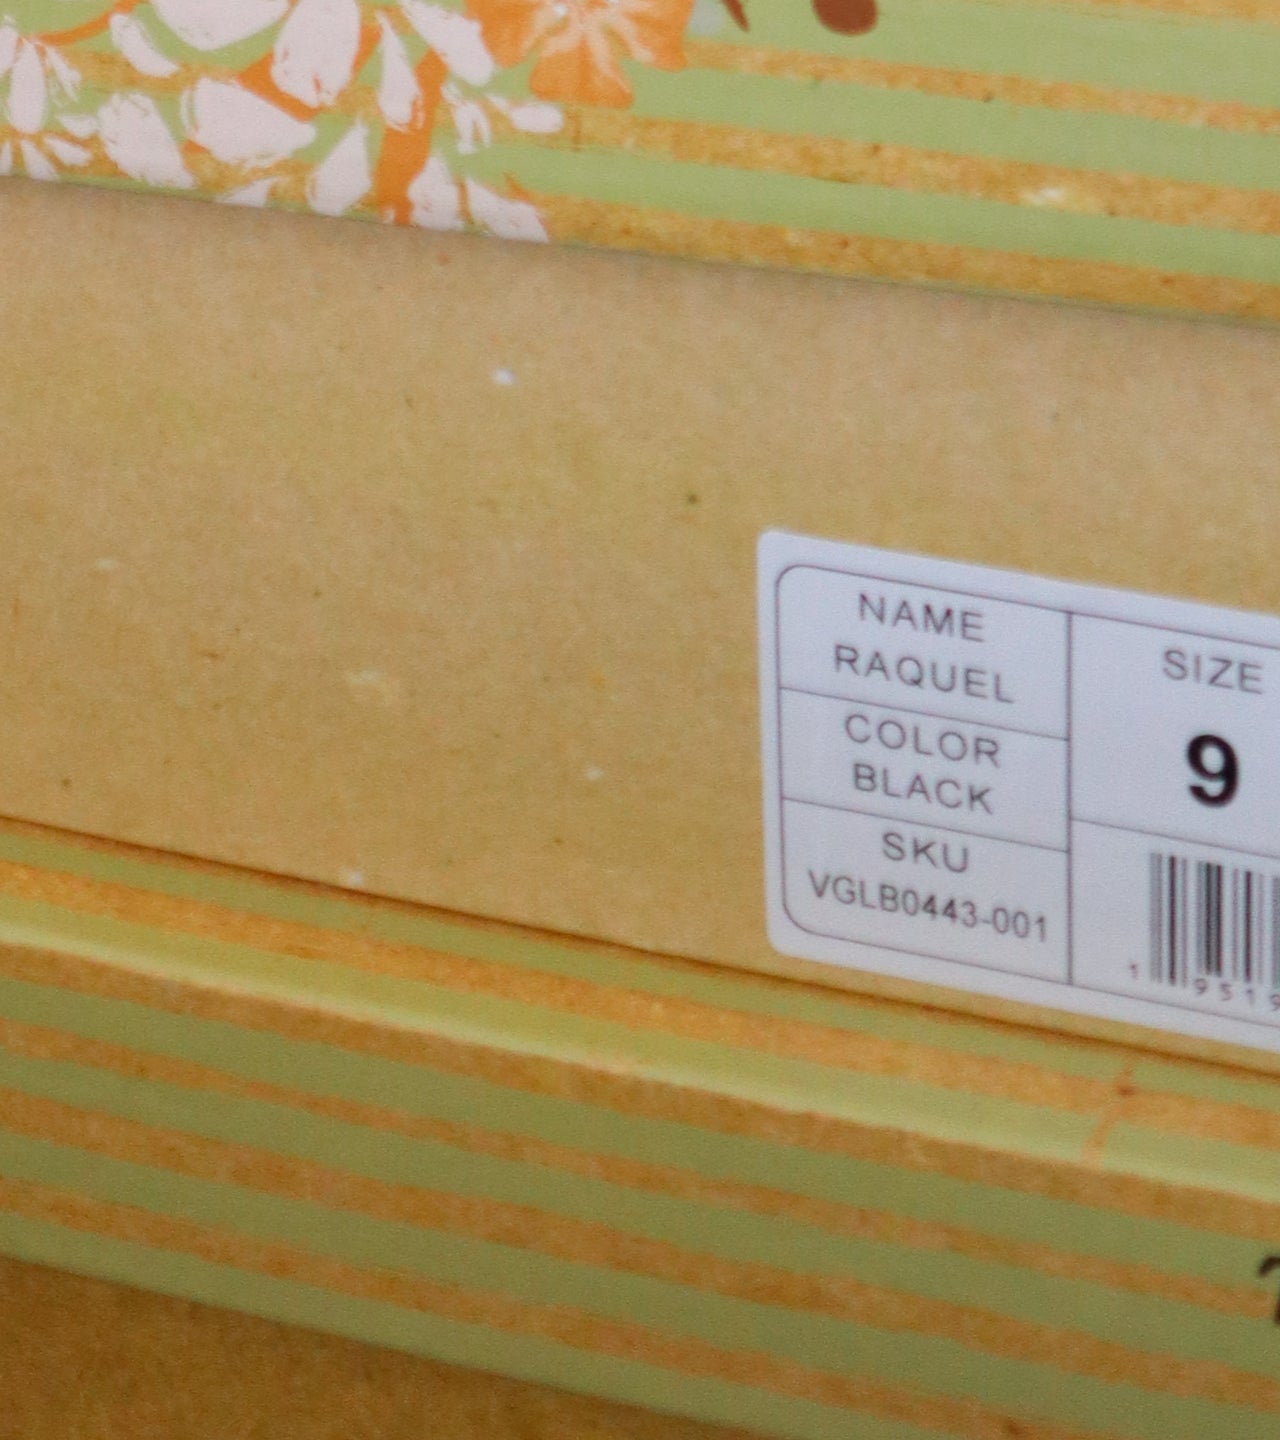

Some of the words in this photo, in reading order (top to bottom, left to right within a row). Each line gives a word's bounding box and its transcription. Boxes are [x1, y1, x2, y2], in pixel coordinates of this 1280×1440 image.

[858, 592, 985, 643] NAME
[833, 643, 1015, 704] RAQUEL
[1162, 648, 1264, 696] SIZE
[844, 713, 1001, 769] COLOR
[852, 762, 994, 816] BLACK
[1187, 733, 1240, 808] 9
[881, 831, 969, 874] SKU
[807, 869, 1048, 943] VGLB0443-001
